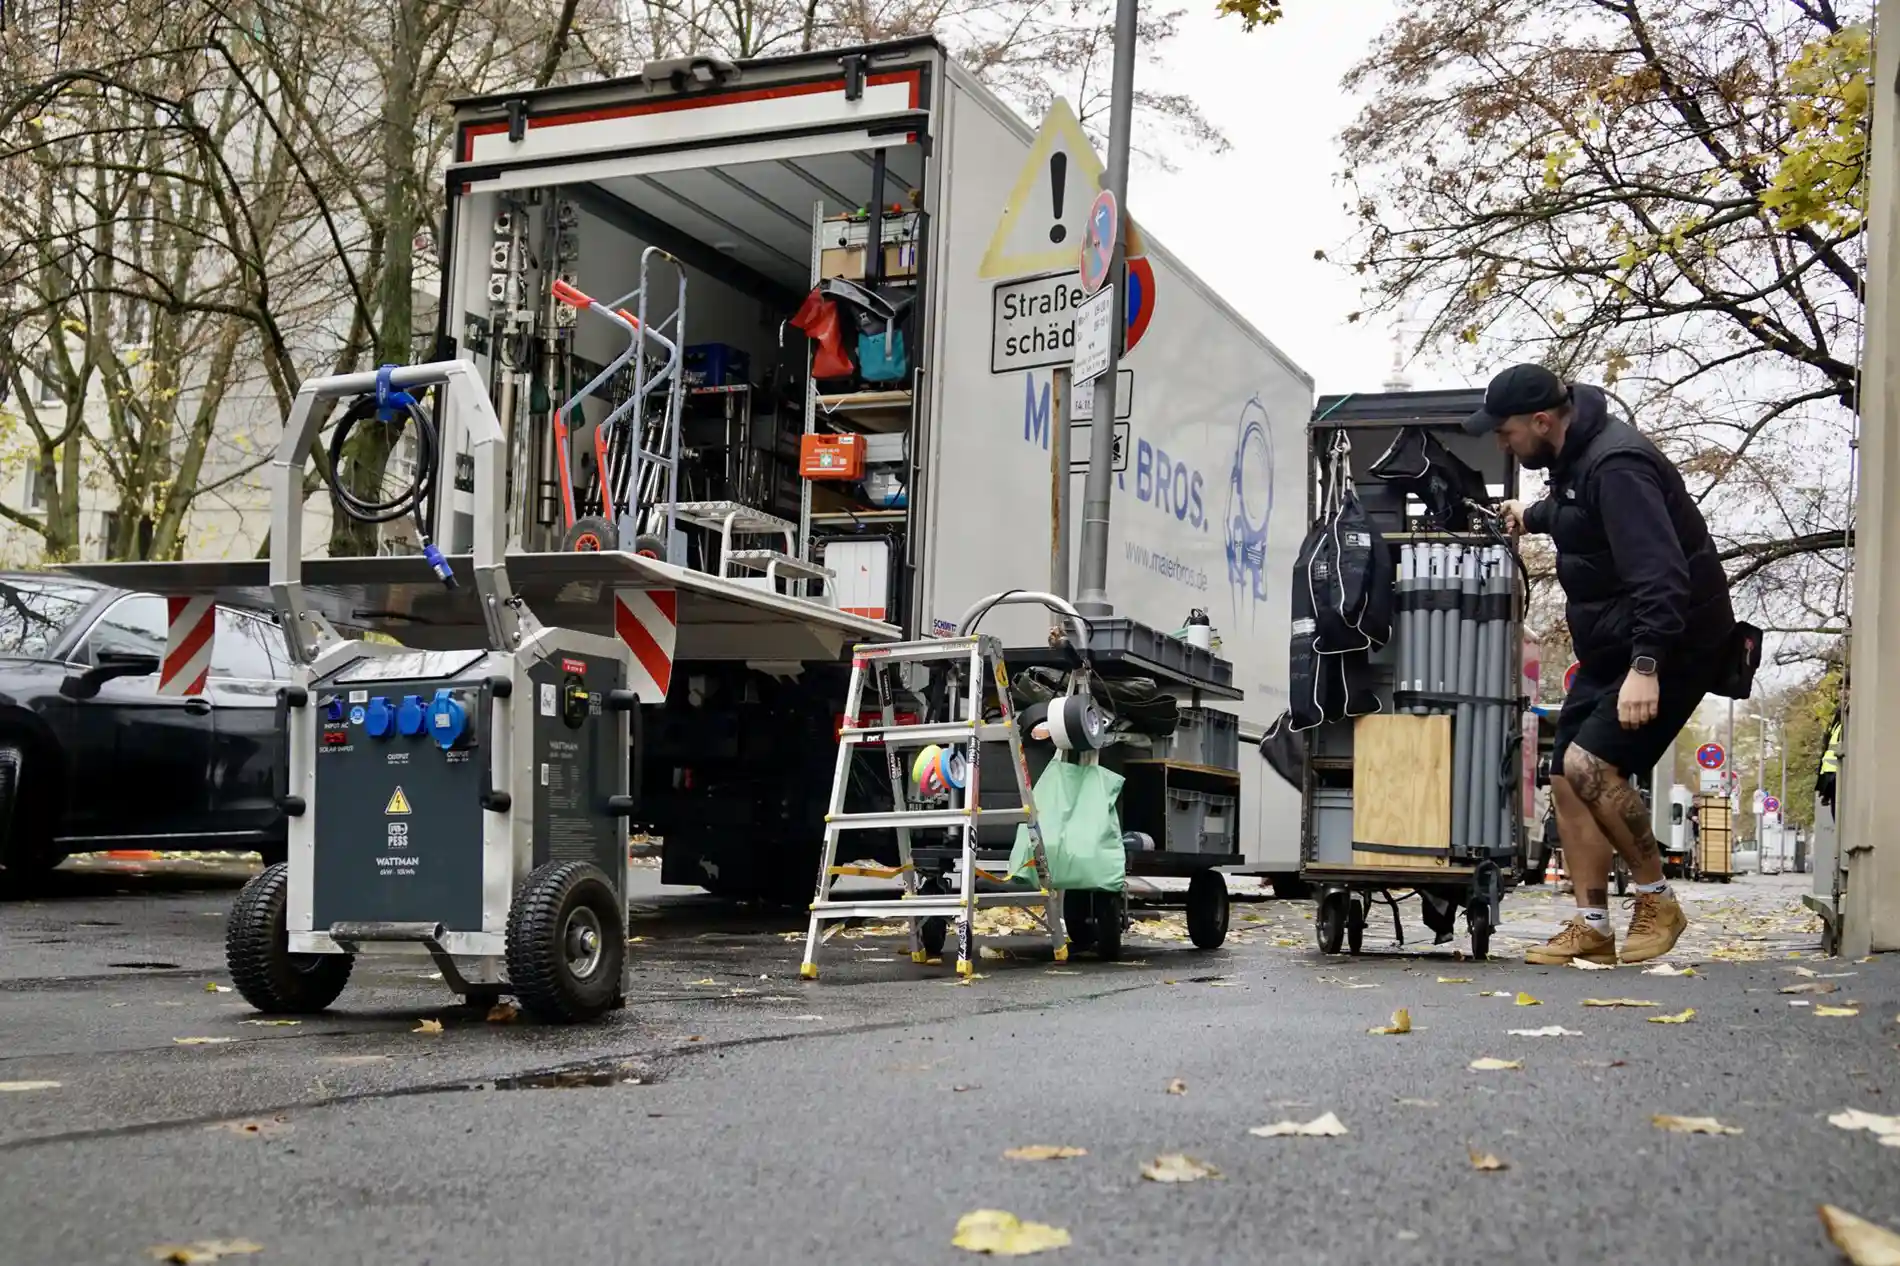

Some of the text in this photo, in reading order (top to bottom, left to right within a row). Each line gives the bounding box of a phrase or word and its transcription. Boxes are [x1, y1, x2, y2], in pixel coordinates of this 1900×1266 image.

[1003, 284, 1090, 320] Straße
[1005, 320, 1075, 356] schäd
[1136, 437, 1208, 532] BROS.
[388, 836, 408, 846] PESS
[376, 857, 419, 866] WATTMAN
